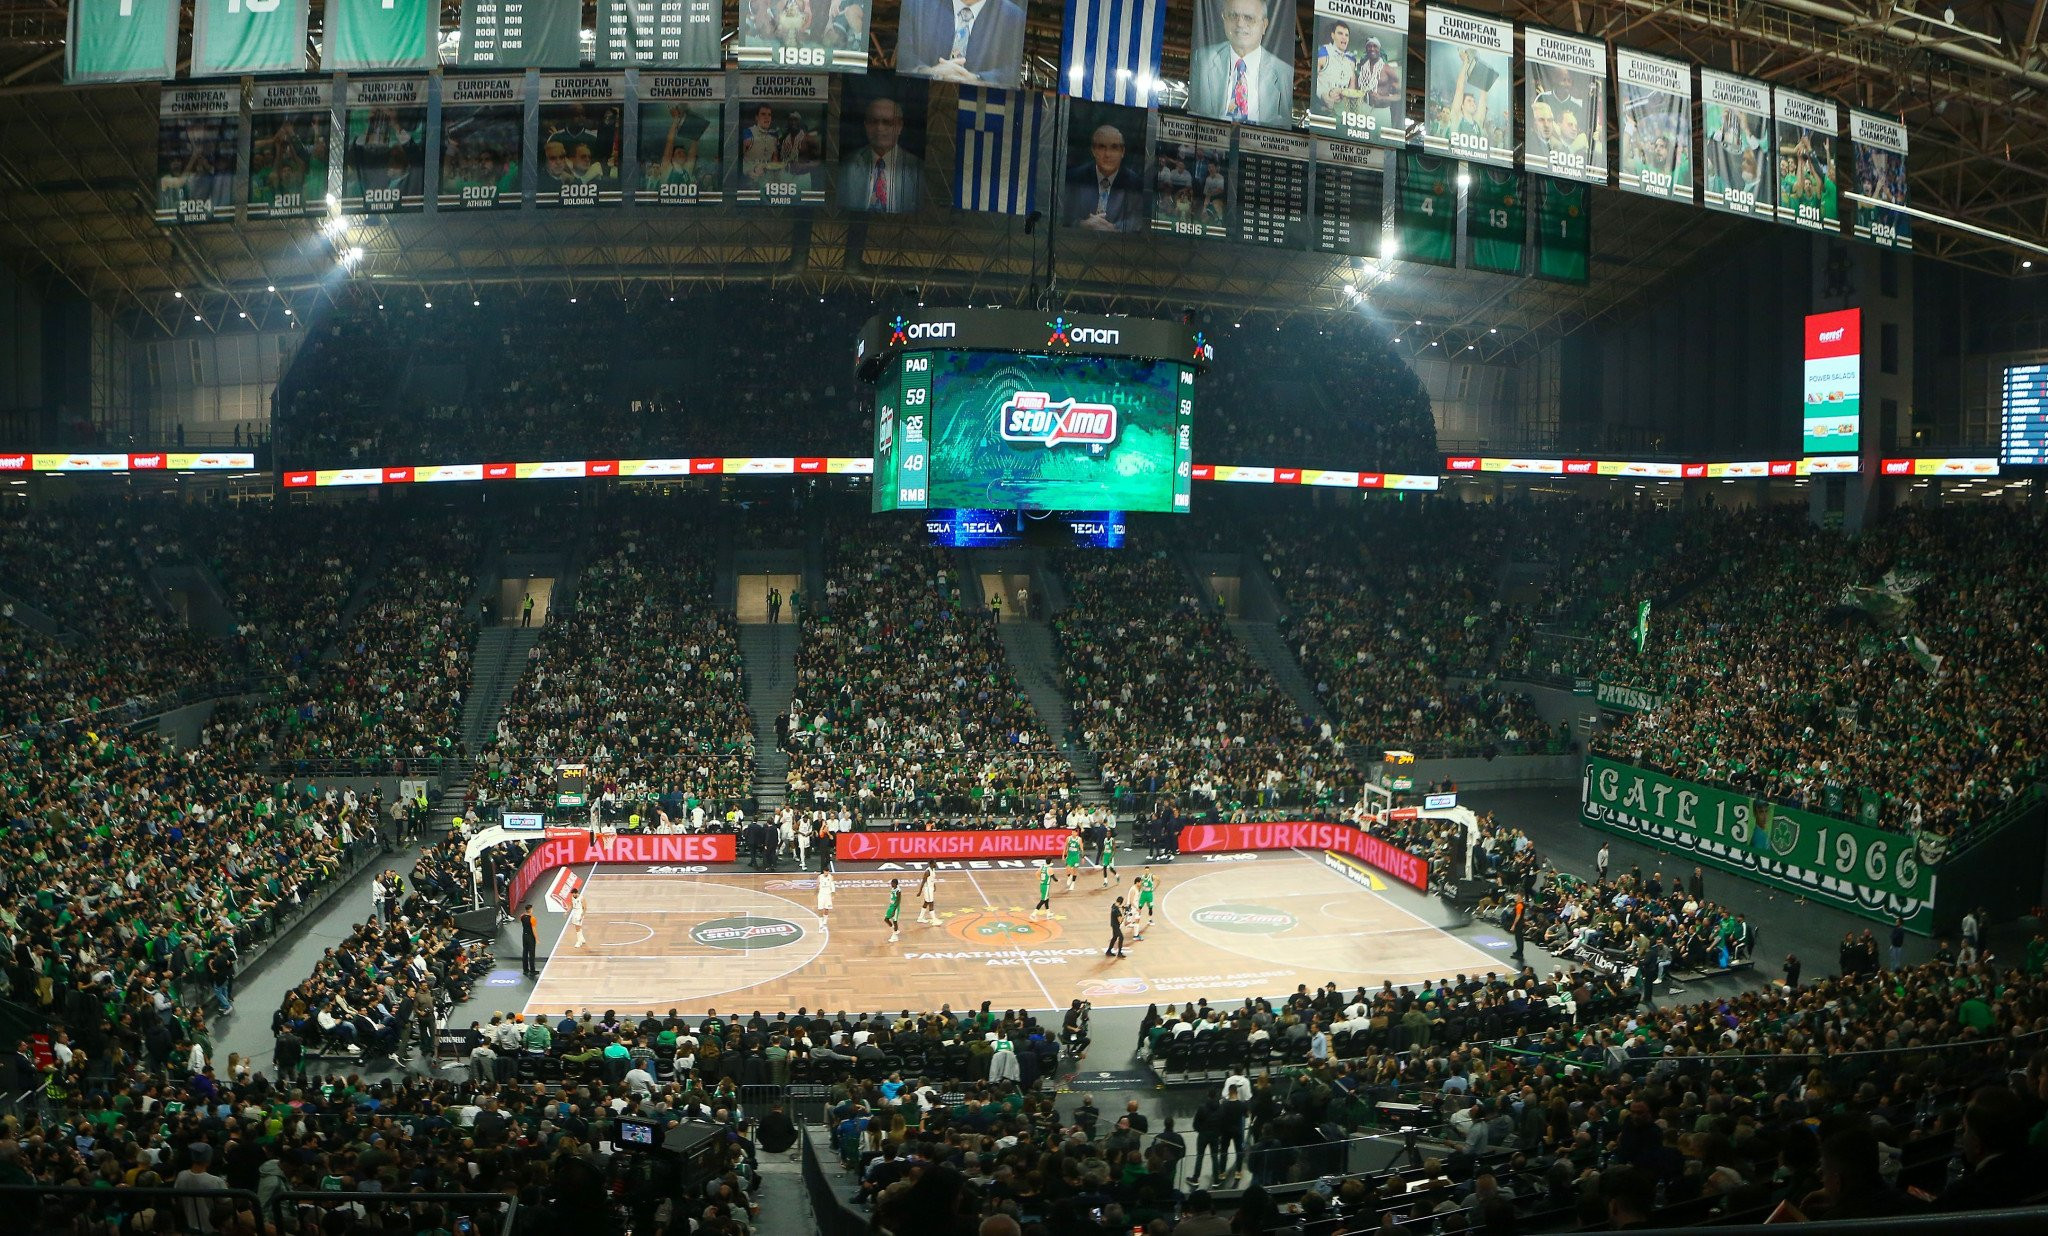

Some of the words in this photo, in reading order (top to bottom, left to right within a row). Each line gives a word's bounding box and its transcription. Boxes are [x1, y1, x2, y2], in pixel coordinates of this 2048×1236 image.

[1328, 1, 1395, 24] CHAMPIONS
[1336, 0, 1392, 12] ROPEAN
[1443, 16, 1497, 36] EUROPEAN
[1439, 26, 1501, 48] CHAMPIONS
[1540, 38, 1591, 58] EUROPEAN
[779, 48, 826, 65] 1996
[1536, 47, 1595, 68] CHAMPIONS
[1631, 60, 1678, 79] EUROPEAN
[457, 81, 510, 93] EUROPEAN
[555, 80, 609, 91] EUROPEAN
[654, 79, 710, 90] EUROPEAN
[756, 77, 812, 88] EUROPEAN
[1628, 70, 1680, 90] CHAMPIONS
[267, 87, 318, 98] EUROPEAN
[362, 82, 414, 94] EUROPEAN
[551, 90, 612, 100] CHAMPIONS
[650, 88, 713, 98] CHAMPIONS
[752, 88, 815, 98] CHAMPIONS
[1714, 81, 1758, 98] EUROPEAN
[175, 91, 226, 102] EUROPEAN
[263, 96, 321, 108] CHAMPIONS
[358, 92, 416, 103] CHAMPIONS
[453, 90, 513, 102] CHAMPIONS
[1712, 90, 1761, 110] CHAMPIONS
[171, 100, 229, 112] CHAMPIONS
[1787, 99, 1826, 117] EUROPEAN
[1341, 111, 1376, 130] 1996
[1784, 108, 1829, 128] CHAMPIONS
[1169, 129, 1184, 138] CUP
[1184, 131, 1218, 142] WINNERS
[1347, 130, 1370, 140] PARIS
[1861, 120, 1898, 138] EUROPEAN
[1241, 132, 1261, 142] GREEK
[1262, 136, 1309, 148] CHAMPIONSHIP
[1450, 132, 1488, 150] 2000
[1860, 128, 1901, 148] CHAMPIONS
[1261, 142, 1290, 152] WINNERS
[1330, 144, 1354, 154] GREEK
[1356, 148, 1371, 157] CUP
[1332, 153, 1368, 166] WINNERS
[1550, 150, 1584, 170] 2002
[1642, 170, 1672, 187] 2007
[365, 189, 400, 202] 2009
[462, 186, 497, 199] 2007
[561, 184, 598, 198] 2002
[660, 184, 698, 197] 2000
[765, 183, 797, 196] 1996
[274, 194, 300, 207] 2011
[770, 198, 791, 206] PARIS
[1725, 188, 1754, 206] 2009
[180, 200, 212, 213] 2024
[1421, 198, 1434, 216] 4
[1799, 204, 1820, 220] 2011
[1489, 208, 1508, 229] 13
[1175, 222, 1202, 236] 1996
[1560, 220, 1567, 238] 1
[1872, 222, 1896, 239] 2024
[906, 358, 928, 372] PAO
[1181, 371, 1193, 385] PAO
[1809, 374, 1831, 383] POWER
[1832, 372, 1856, 381] SALADS
[906, 388, 926, 406] 59
[1180, 399, 1191, 415] 59
[904, 454, 924, 472] 48
[1178, 461, 1190, 478] 48
[900, 488, 925, 502] RMB
[1174, 494, 1190, 506] RMB
[962, 523, 1003, 533] TESLA
[1070, 524, 1105, 534] TESLA
[1597, 683, 1662, 712] PATISSIA
[1599, 768, 1698, 829] GATE
[1714, 800, 1750, 843] 13
[1815, 827, 1920, 890] 1966
[584, 837, 718, 861] AIRLINES
[888, 836, 974, 854] TURKISH
[980, 834, 1067, 852] AIRLINES
[1240, 824, 1350, 850] TURKISH
[1354, 833, 1418, 885] AIRLINES
[878, 860, 1054, 870] ATHENS
[904, 948, 1098, 960] PANATHINAIKOS
[985, 957, 1068, 966] AKTOR
[1594, 954, 1614, 970] Uber
